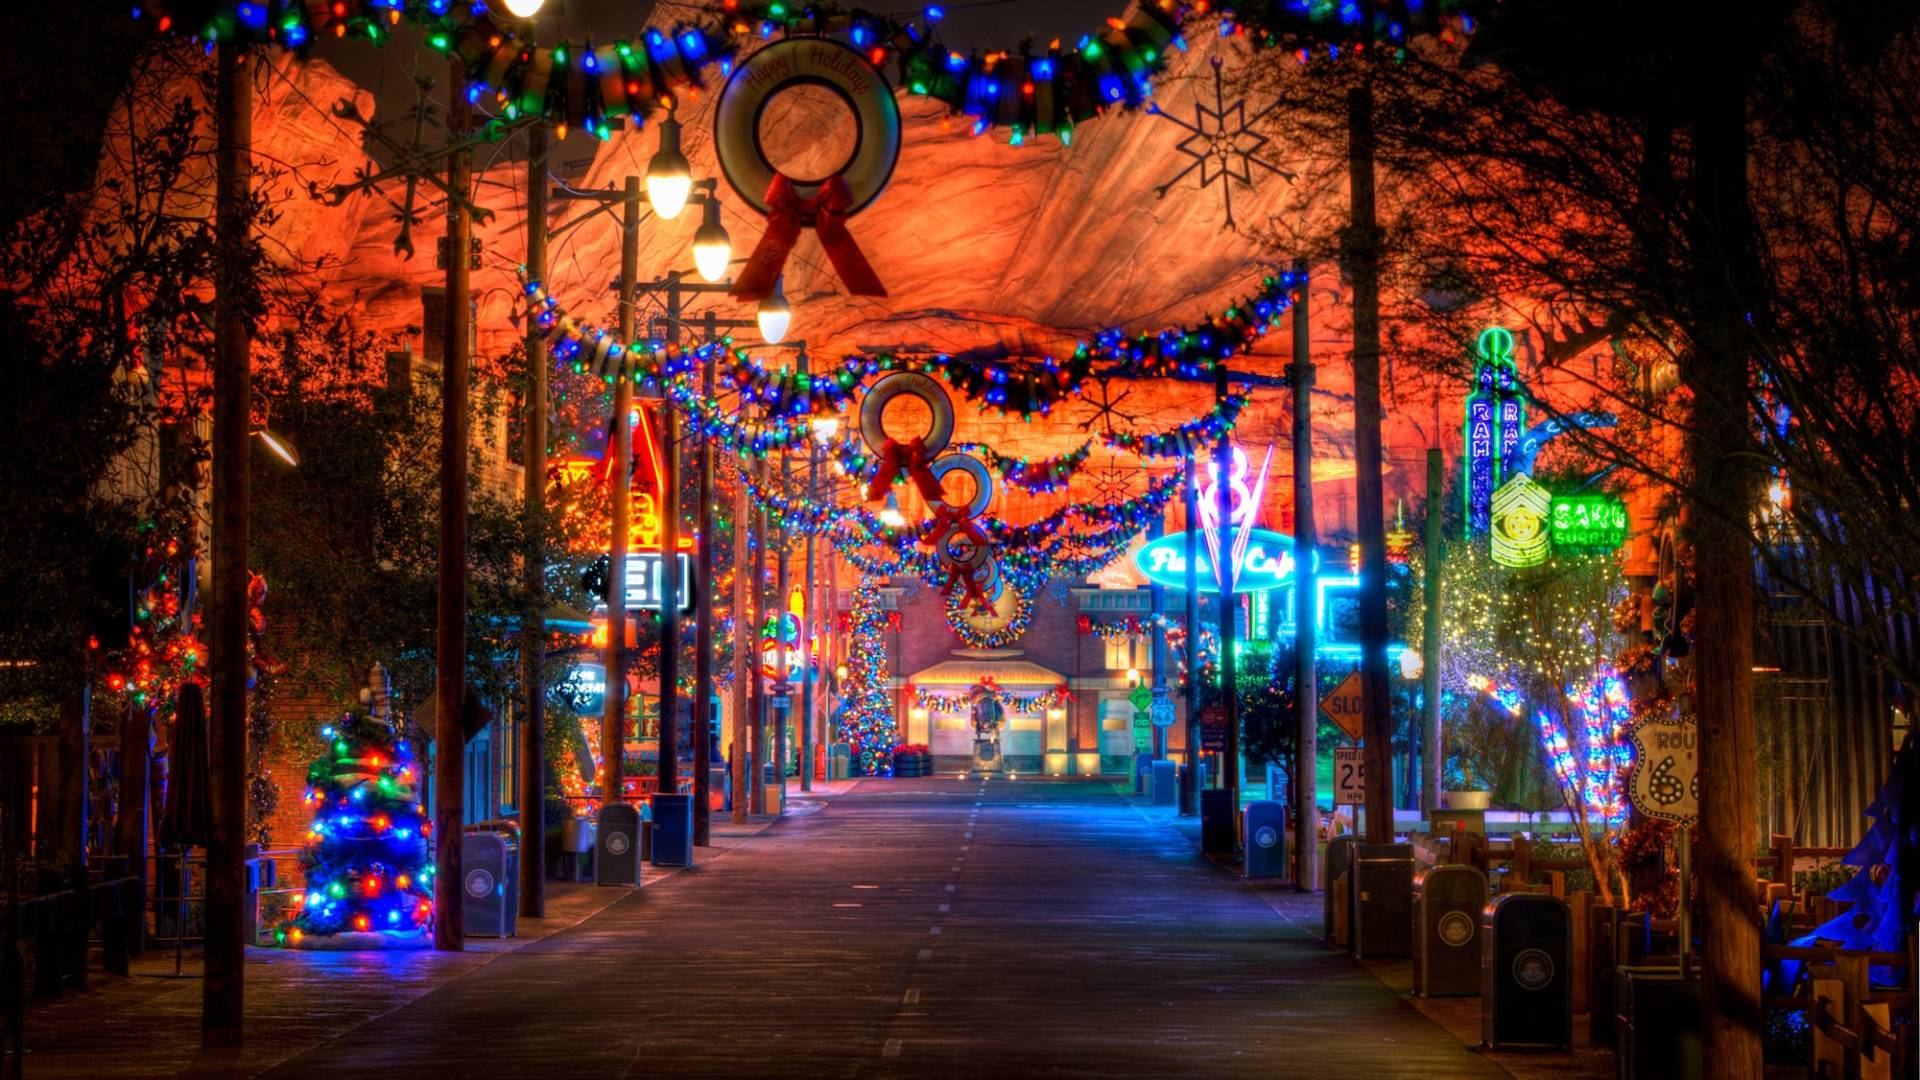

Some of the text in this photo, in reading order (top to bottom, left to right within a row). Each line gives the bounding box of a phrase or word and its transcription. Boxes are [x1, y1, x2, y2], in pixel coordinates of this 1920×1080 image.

[744, 46, 870, 95] Happy Holidays
[1331, 696, 1362, 715] SLO
[1655, 731, 1697, 750] ROU
[1336, 751, 1357, 761] SPEED
